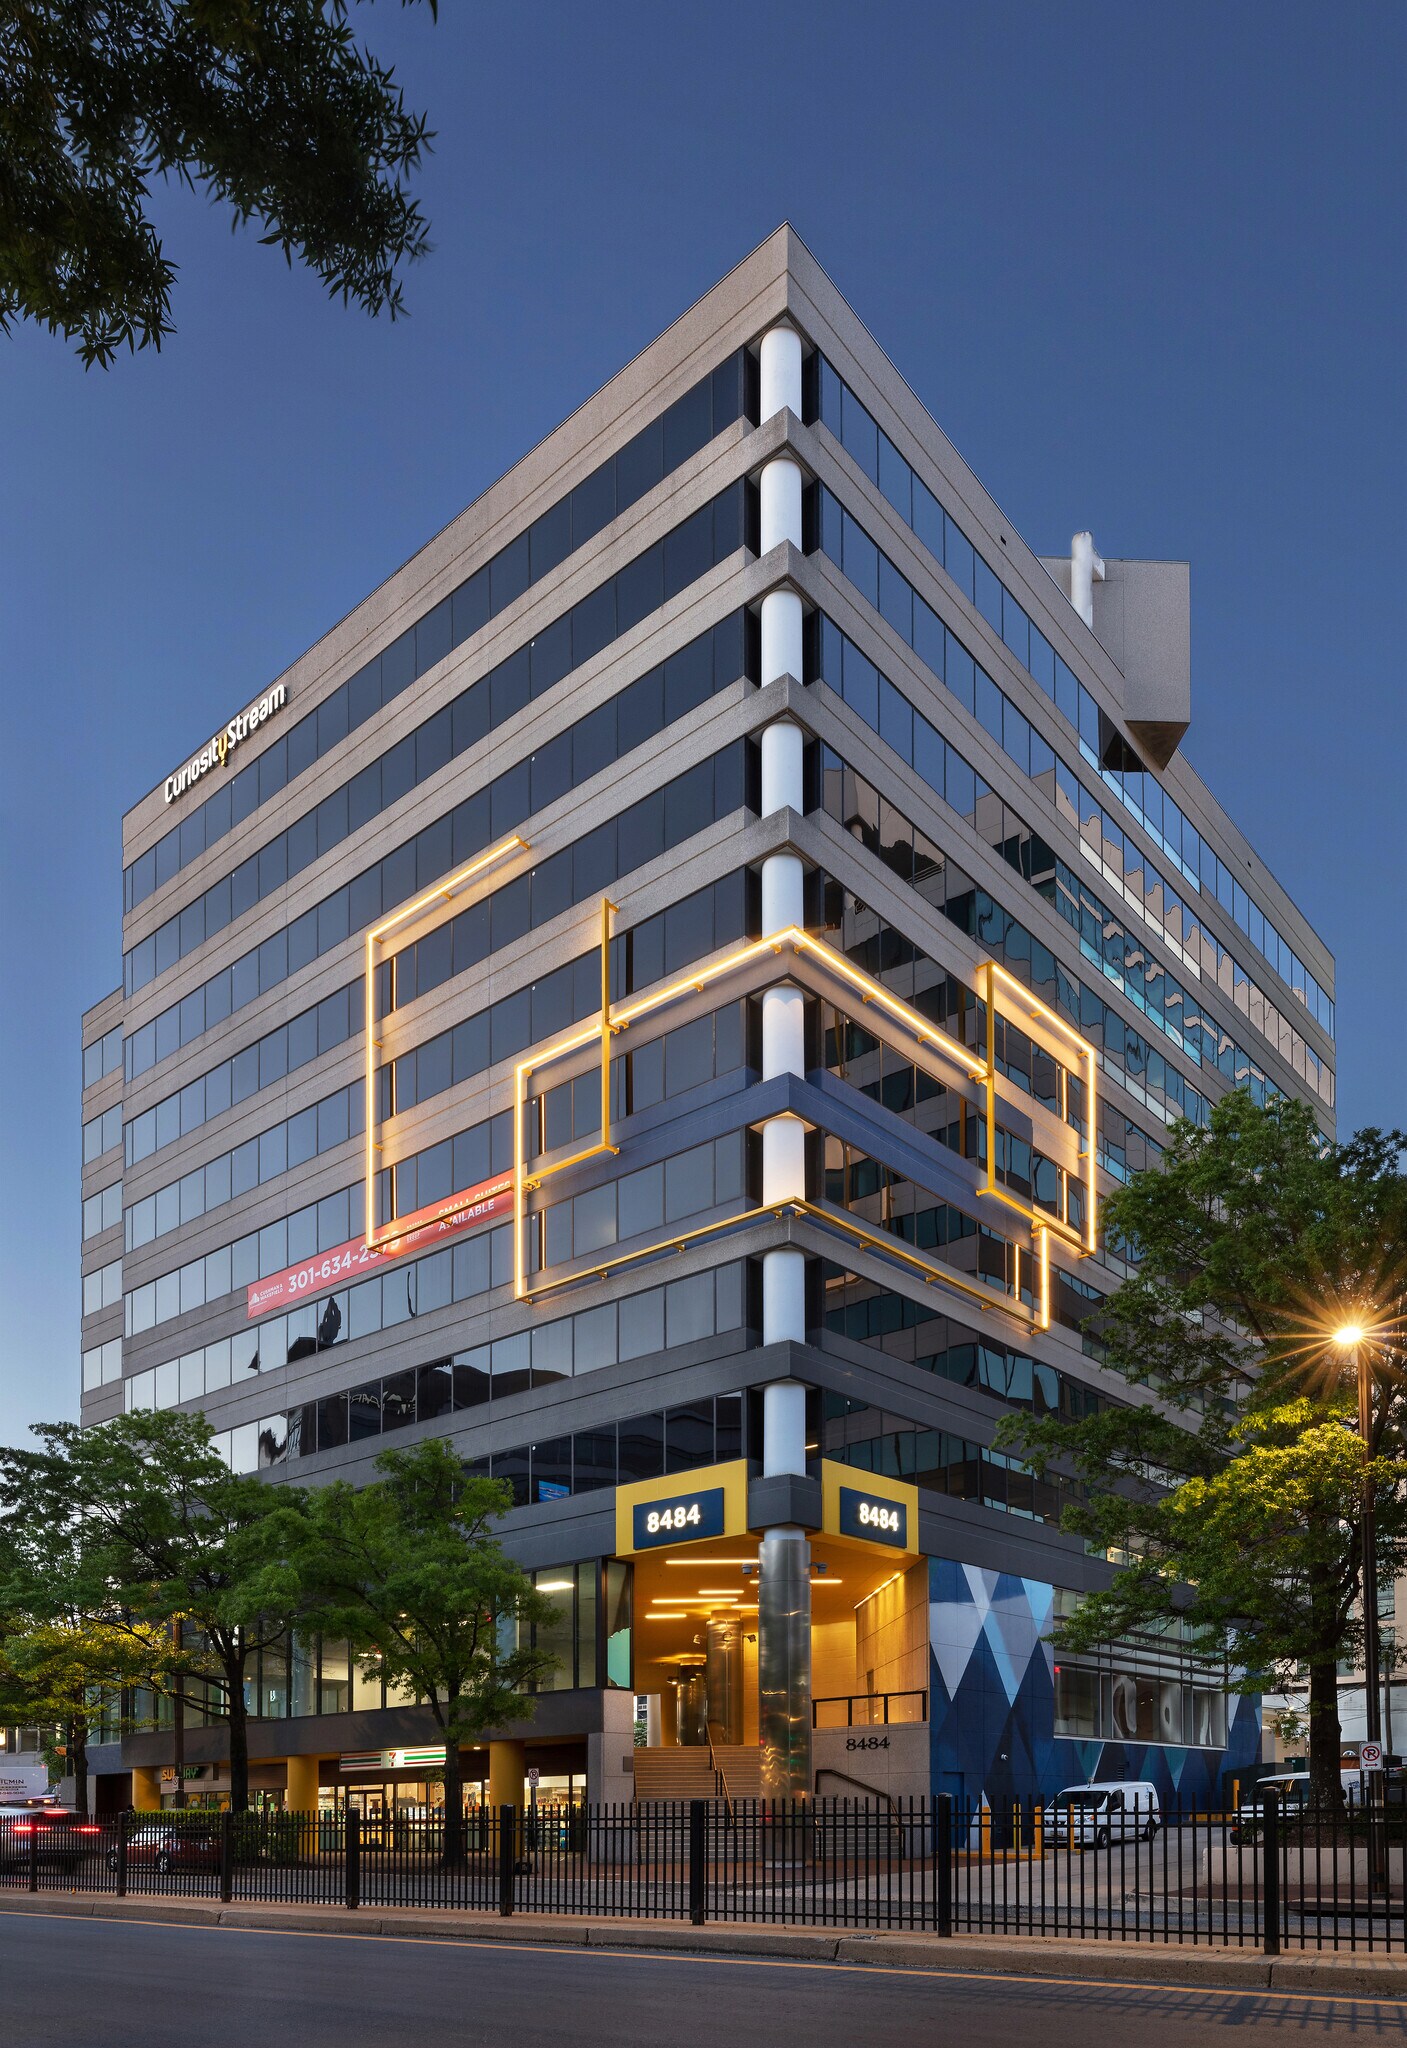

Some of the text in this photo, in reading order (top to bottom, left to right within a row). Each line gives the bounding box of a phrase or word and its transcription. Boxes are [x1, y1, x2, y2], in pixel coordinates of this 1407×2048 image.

[164, 684, 286, 804] CuriosityStream
[647, 1504, 700, 1533] 8484
[859, 1503, 899, 1532] 8484
[846, 1736, 890, 1751] 8484
[161, 1767, 198, 1781] SUAY
